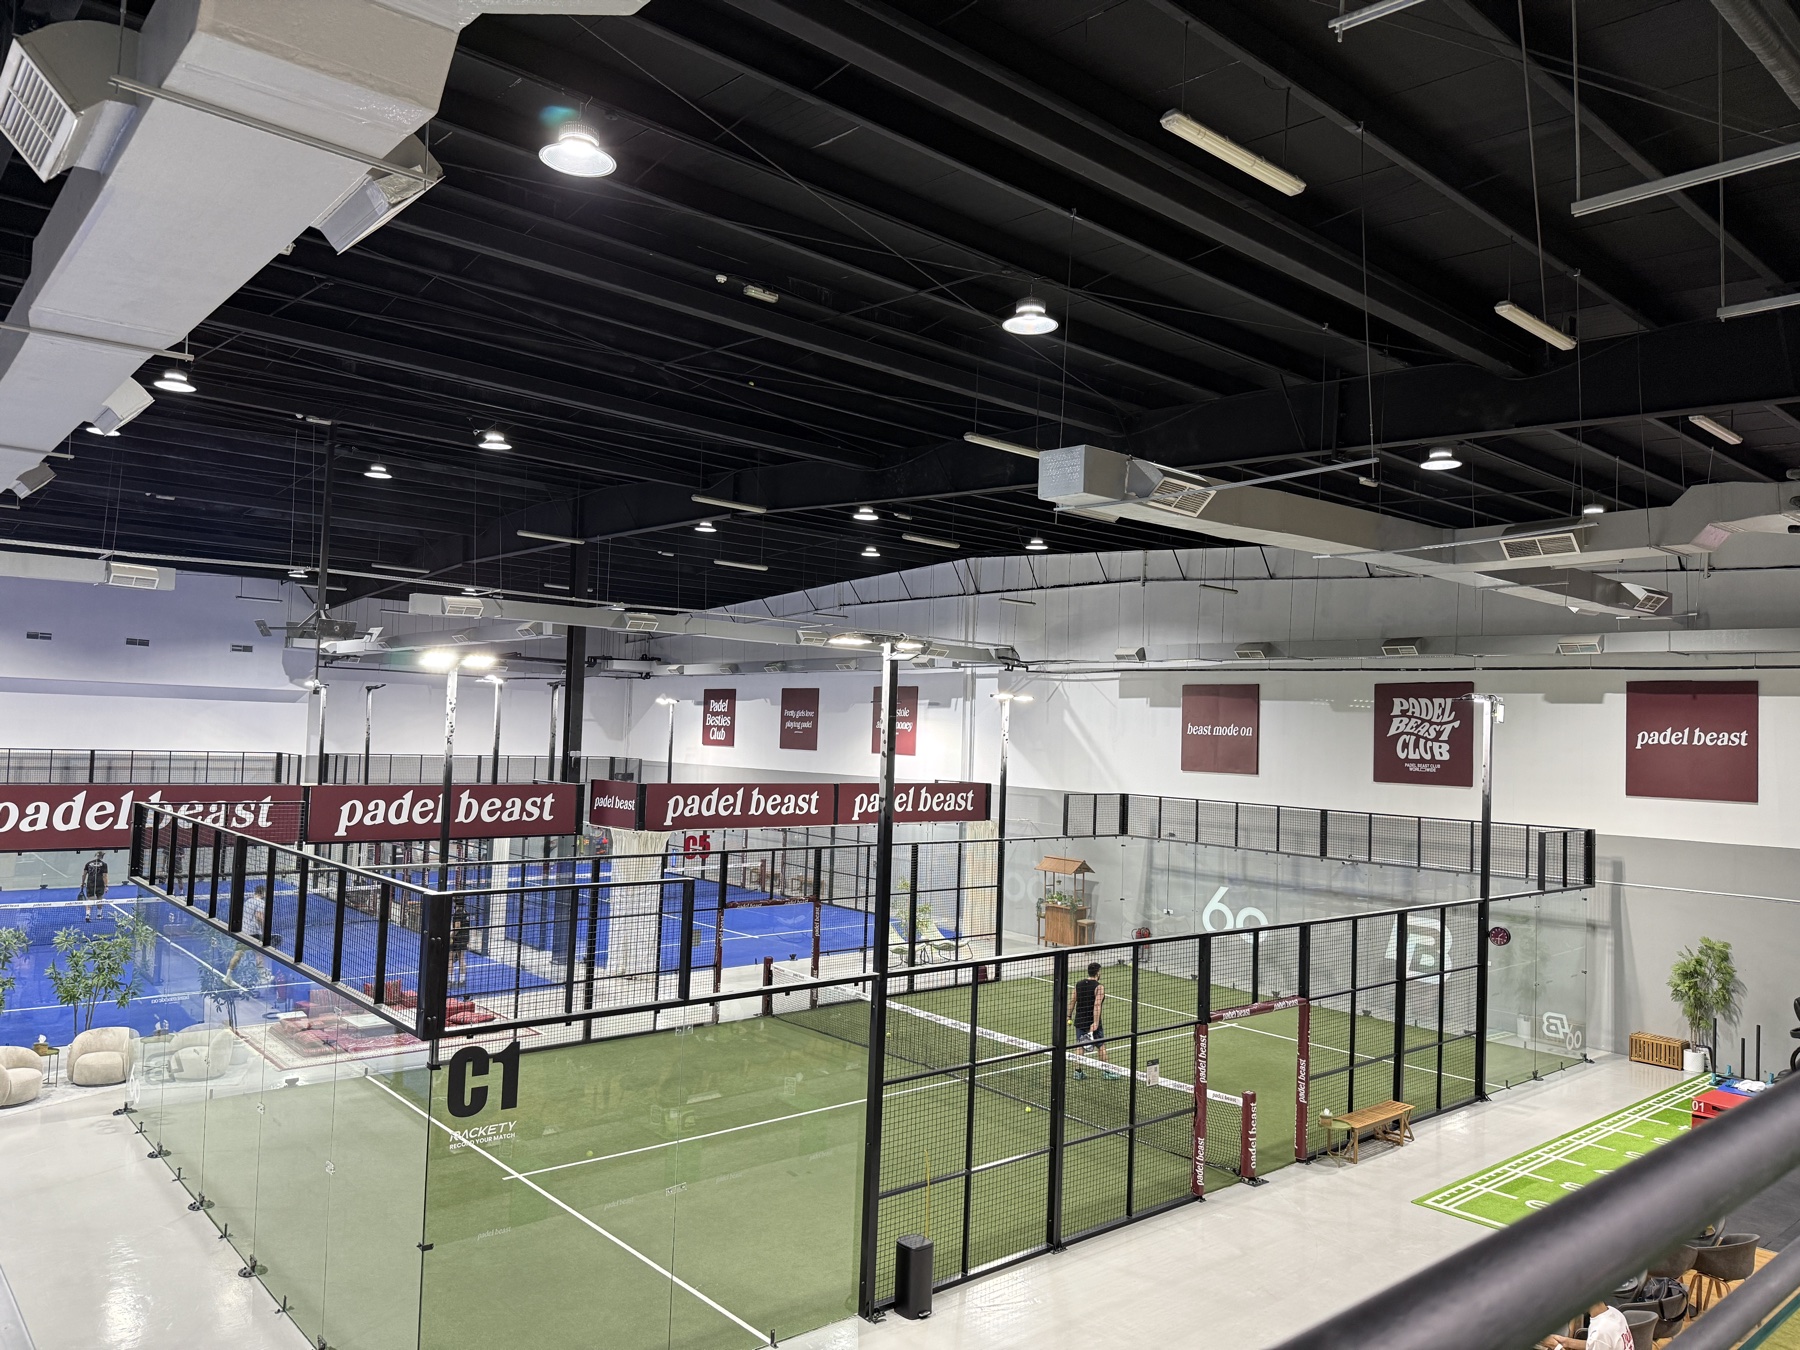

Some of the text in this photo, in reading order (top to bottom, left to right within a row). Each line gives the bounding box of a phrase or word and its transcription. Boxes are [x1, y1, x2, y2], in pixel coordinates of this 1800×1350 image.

[709, 699, 728, 712] Padel
[1390, 697, 1456, 722] PADEL
[706, 714, 731, 726] Besties
[1187, 722, 1253, 736] beast mode on
[1386, 717, 1460, 740] BEAST
[709, 727, 725, 740] Club
[1636, 727, 1748, 749] padel beast
[1396, 734, 1450, 760] CLUB
[455, 789, 555, 824] beast
[594, 795, 635, 811] padel beast
[664, 787, 819, 825] padel beast
[852, 786, 974, 820] pael beast
[684, 835, 710, 860] C5
[1199, 1034, 1207, 1083] padel beast
[447, 1042, 521, 1118] C1
[1298, 1081, 1307, 1103] padel
[1692, 1101, 1704, 1112] 01
[450, 1120, 517, 1142] RACKETY
[476, 1136, 492, 1144] YOUR
[493, 1132, 516, 1140] MATCH
[1196, 1137, 1205, 1186] padel beast
